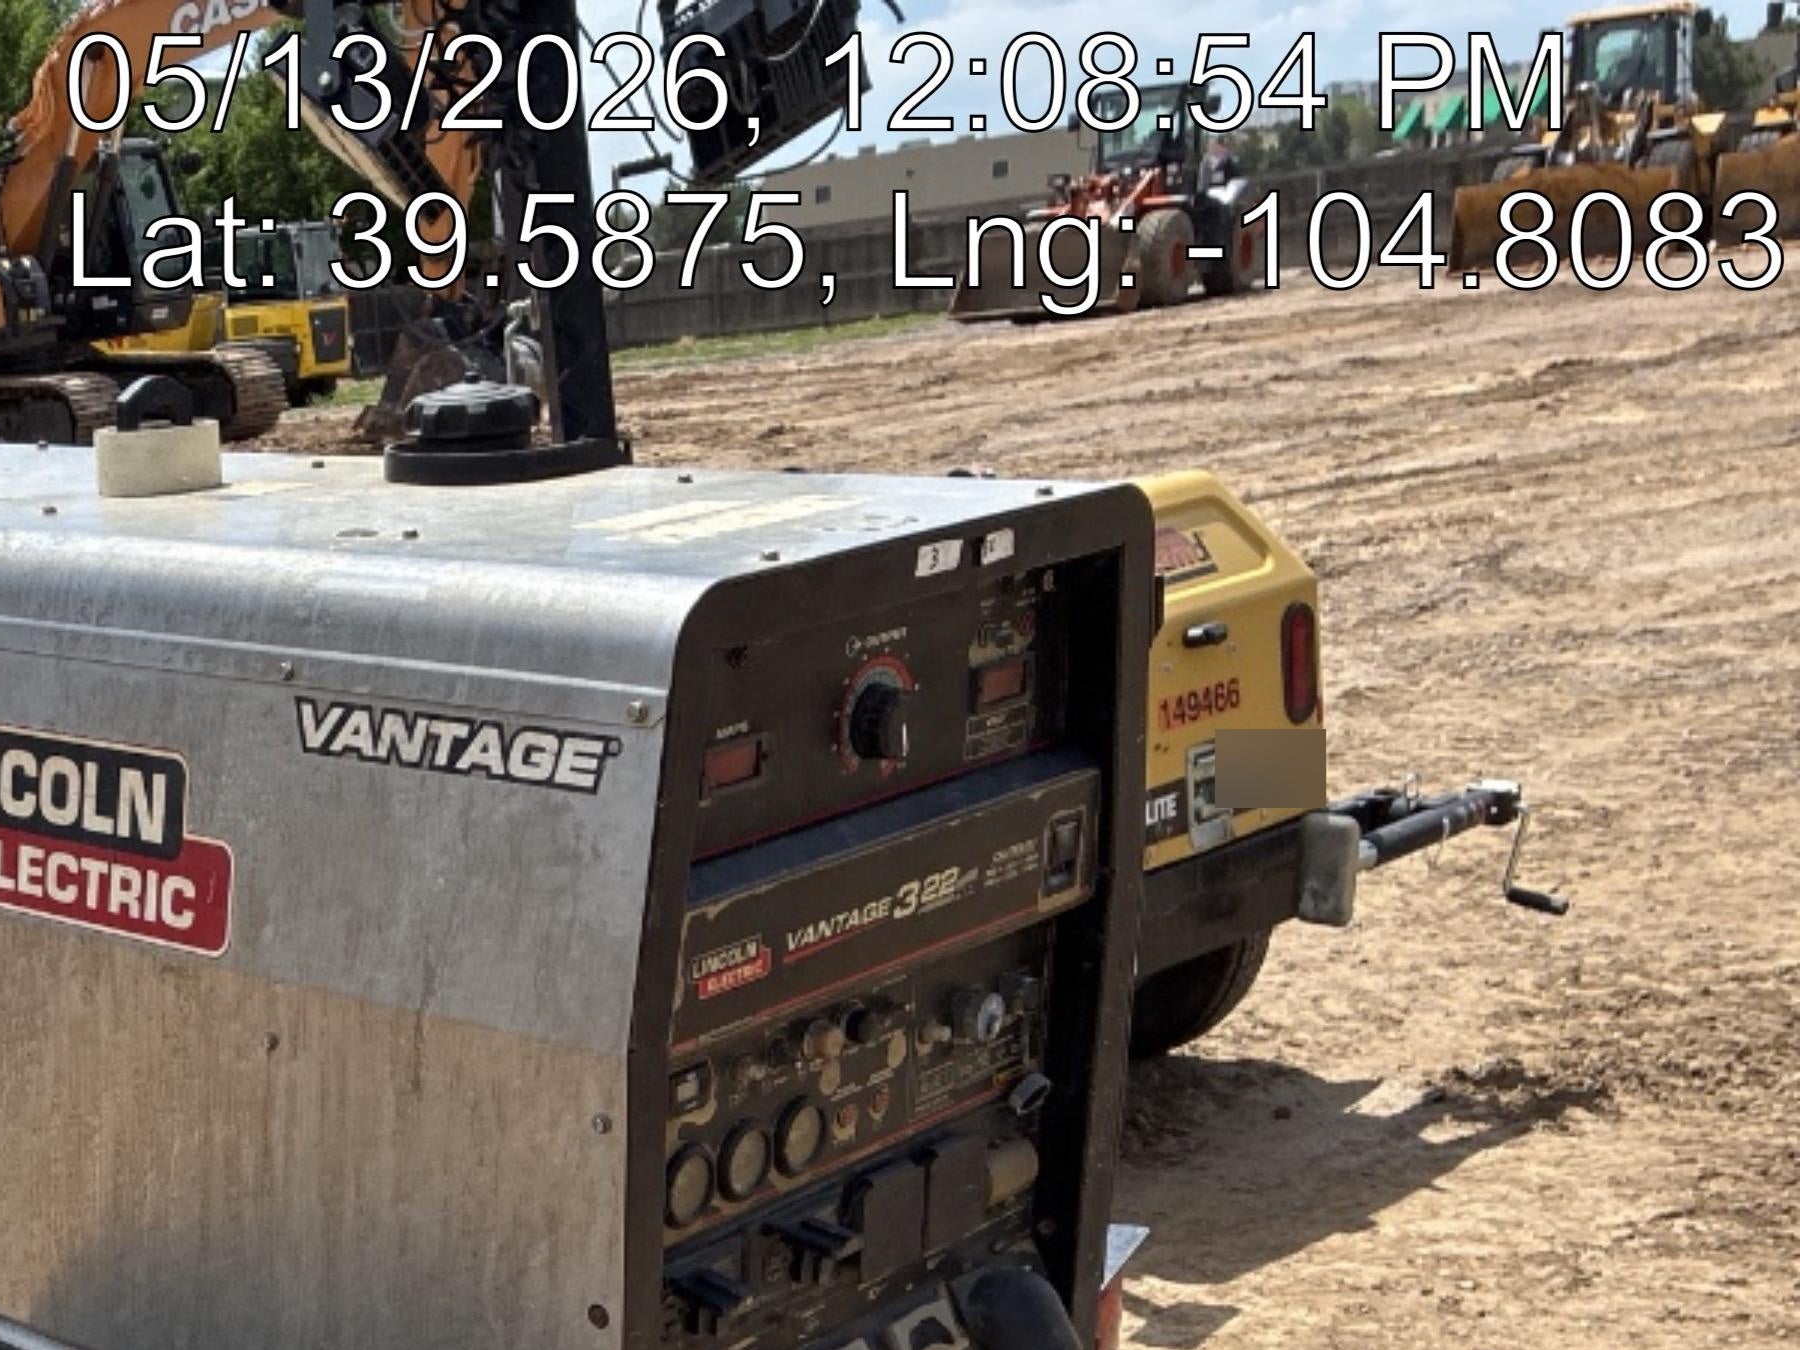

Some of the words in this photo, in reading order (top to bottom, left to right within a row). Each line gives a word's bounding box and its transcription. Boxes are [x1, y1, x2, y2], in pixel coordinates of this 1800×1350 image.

[1160, 678, 1241, 730] 149466
[296, 699, 612, 793] VANTAGE
[785, 895, 893, 951] VANTAGE
[893, 865, 960, 920] 322
[691, 941, 759, 980] LINCOLN
[706, 958, 765, 994] ELECTRIC
